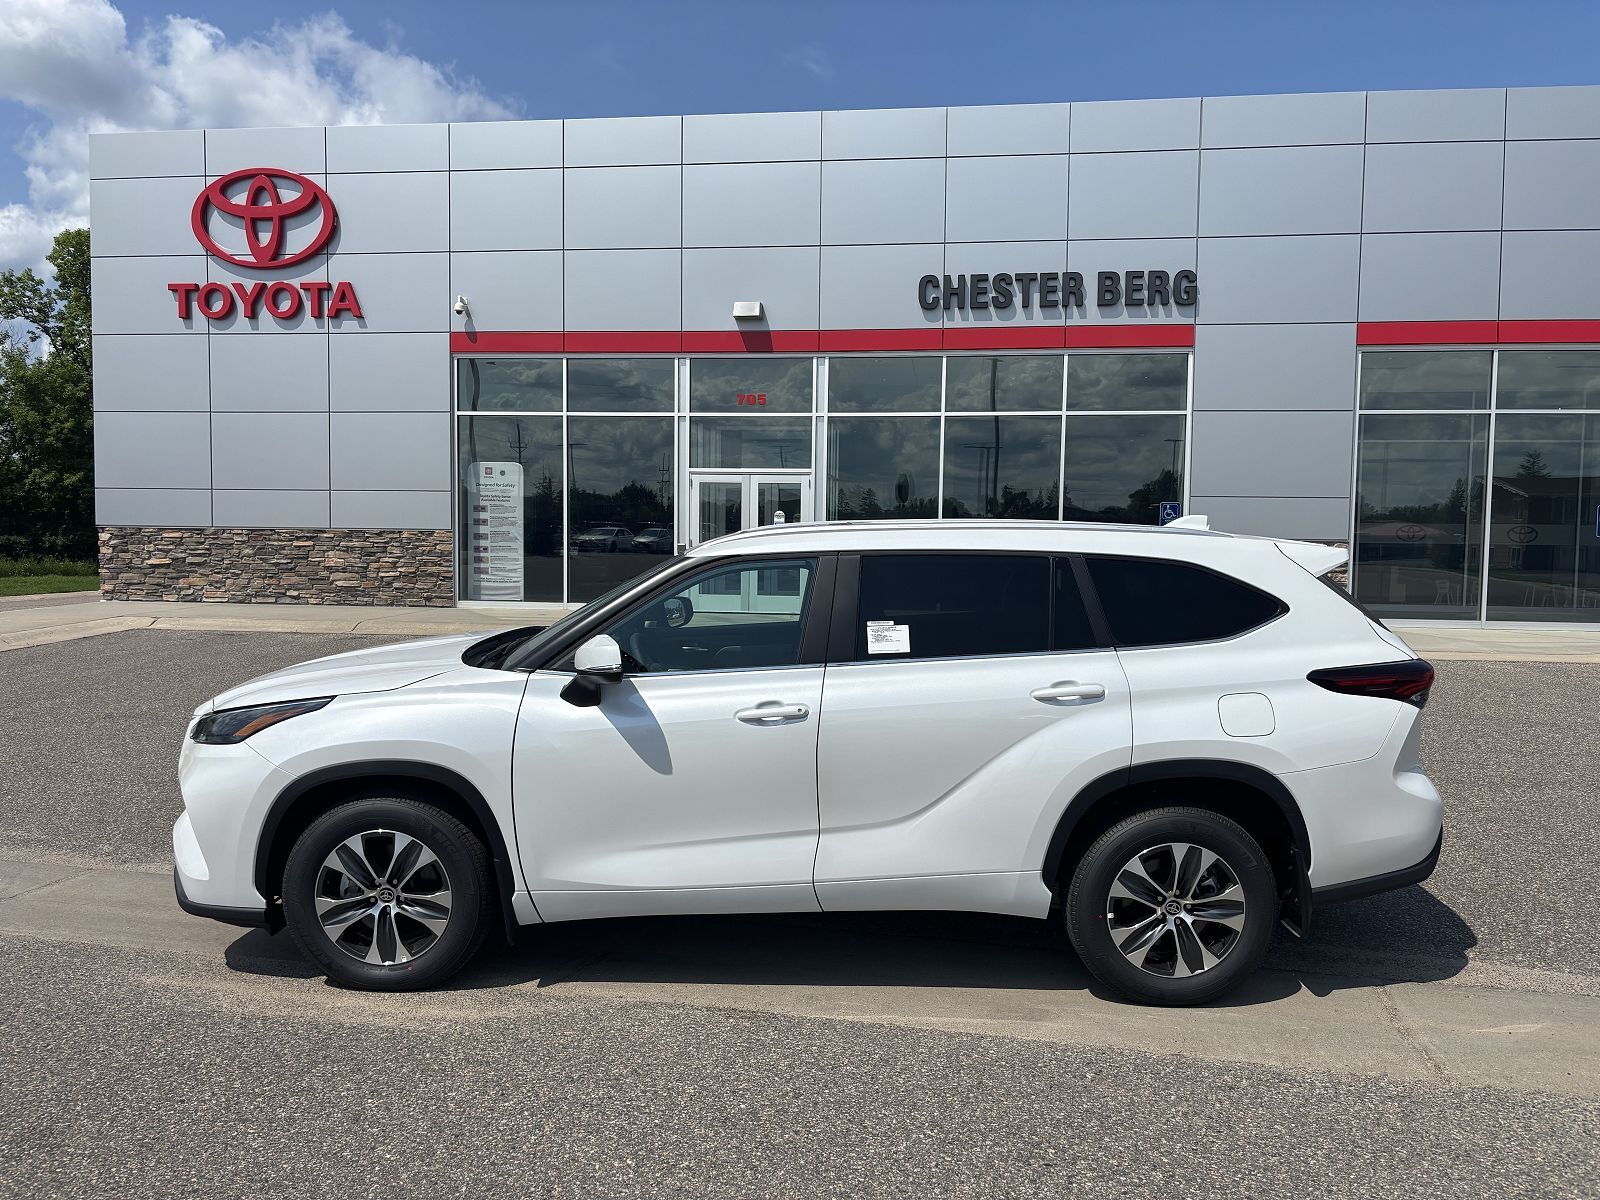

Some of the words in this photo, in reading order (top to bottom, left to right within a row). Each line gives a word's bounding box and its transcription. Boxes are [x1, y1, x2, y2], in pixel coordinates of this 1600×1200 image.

[167, 281, 365, 320] TOYOTA
[918, 272, 1085, 310] CHESTER
[1097, 269, 1198, 307] BERG
[736, 393, 767, 406] 705
